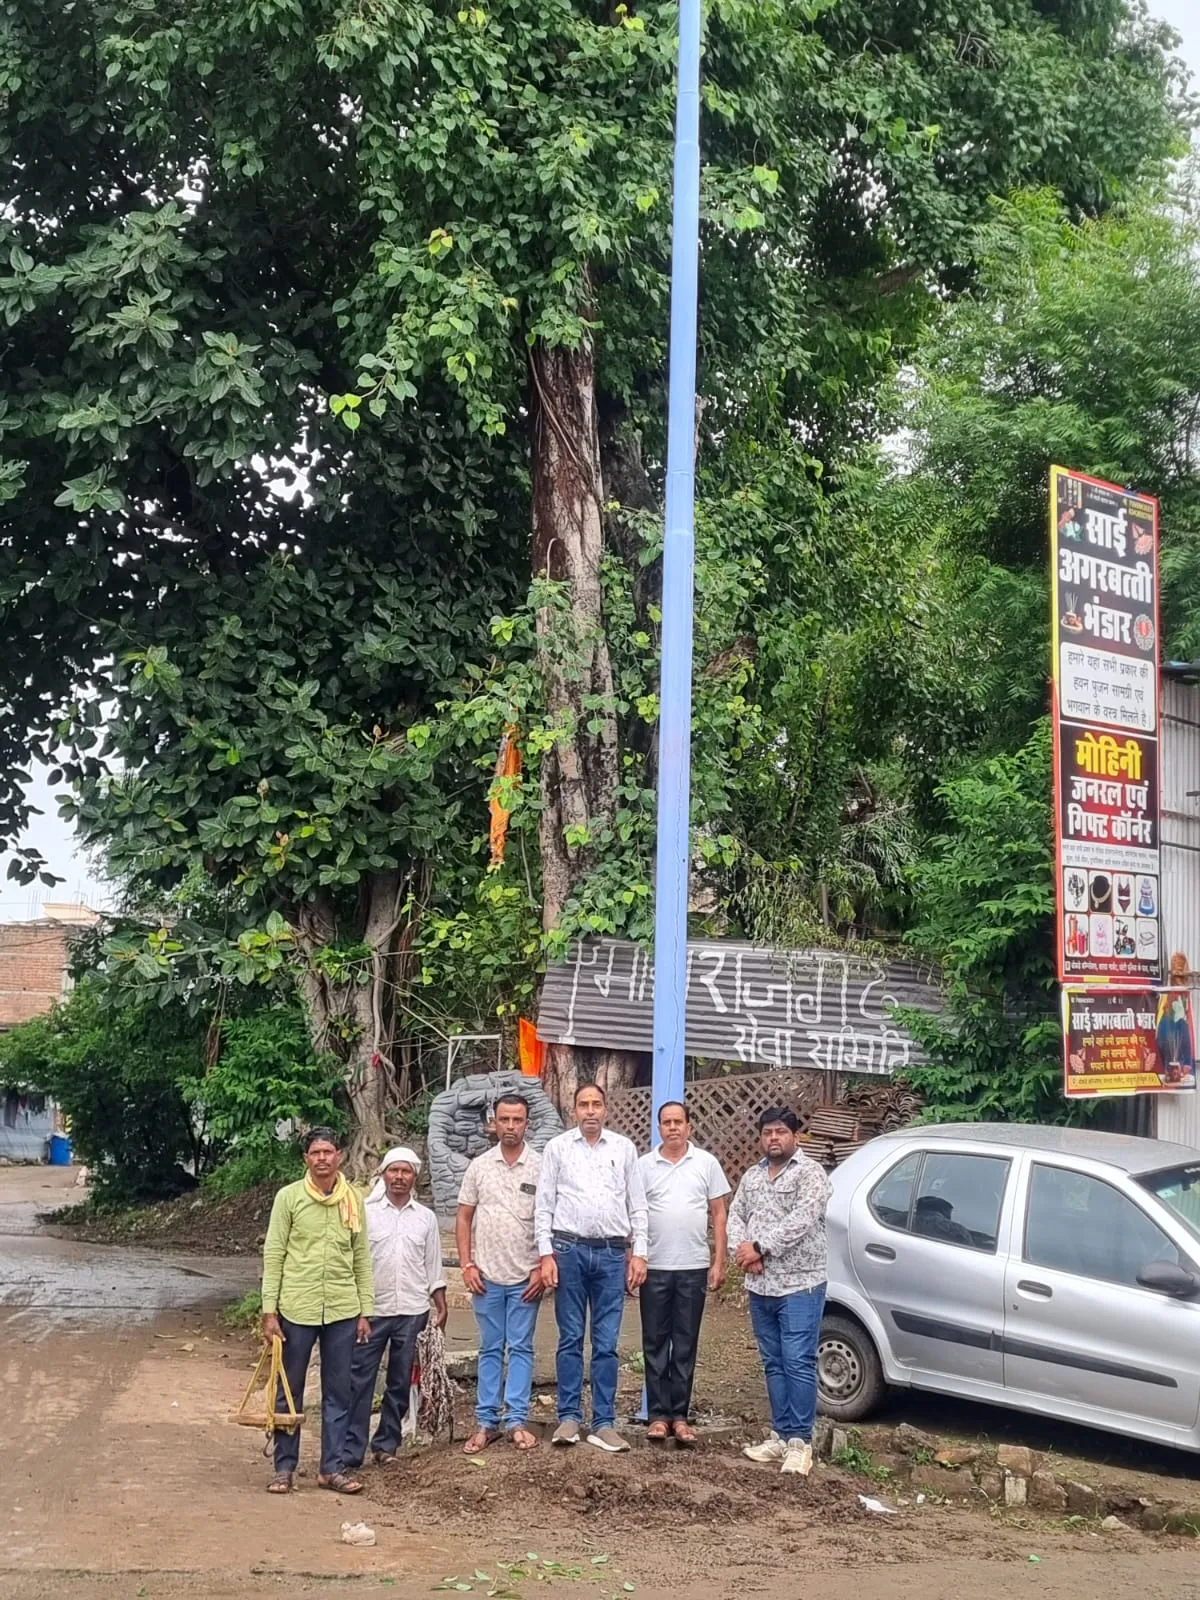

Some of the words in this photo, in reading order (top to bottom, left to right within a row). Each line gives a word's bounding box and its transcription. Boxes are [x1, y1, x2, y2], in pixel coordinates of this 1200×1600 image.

[1084, 507, 1128, 558] साई
[1059, 547, 1153, 604] अगरबत्ती
[1084, 595, 1133, 644] भंडार
[1075, 731, 1142, 780] मोहिनी
[1070, 775, 1123, 807] जनरल
[1124, 780, 1149, 810] एवं
[1067, 802, 1109, 838] गिफ्ट
[1110, 809, 1152, 844] कॉर्नर
[732, 1012, 796, 1068] सेवा
